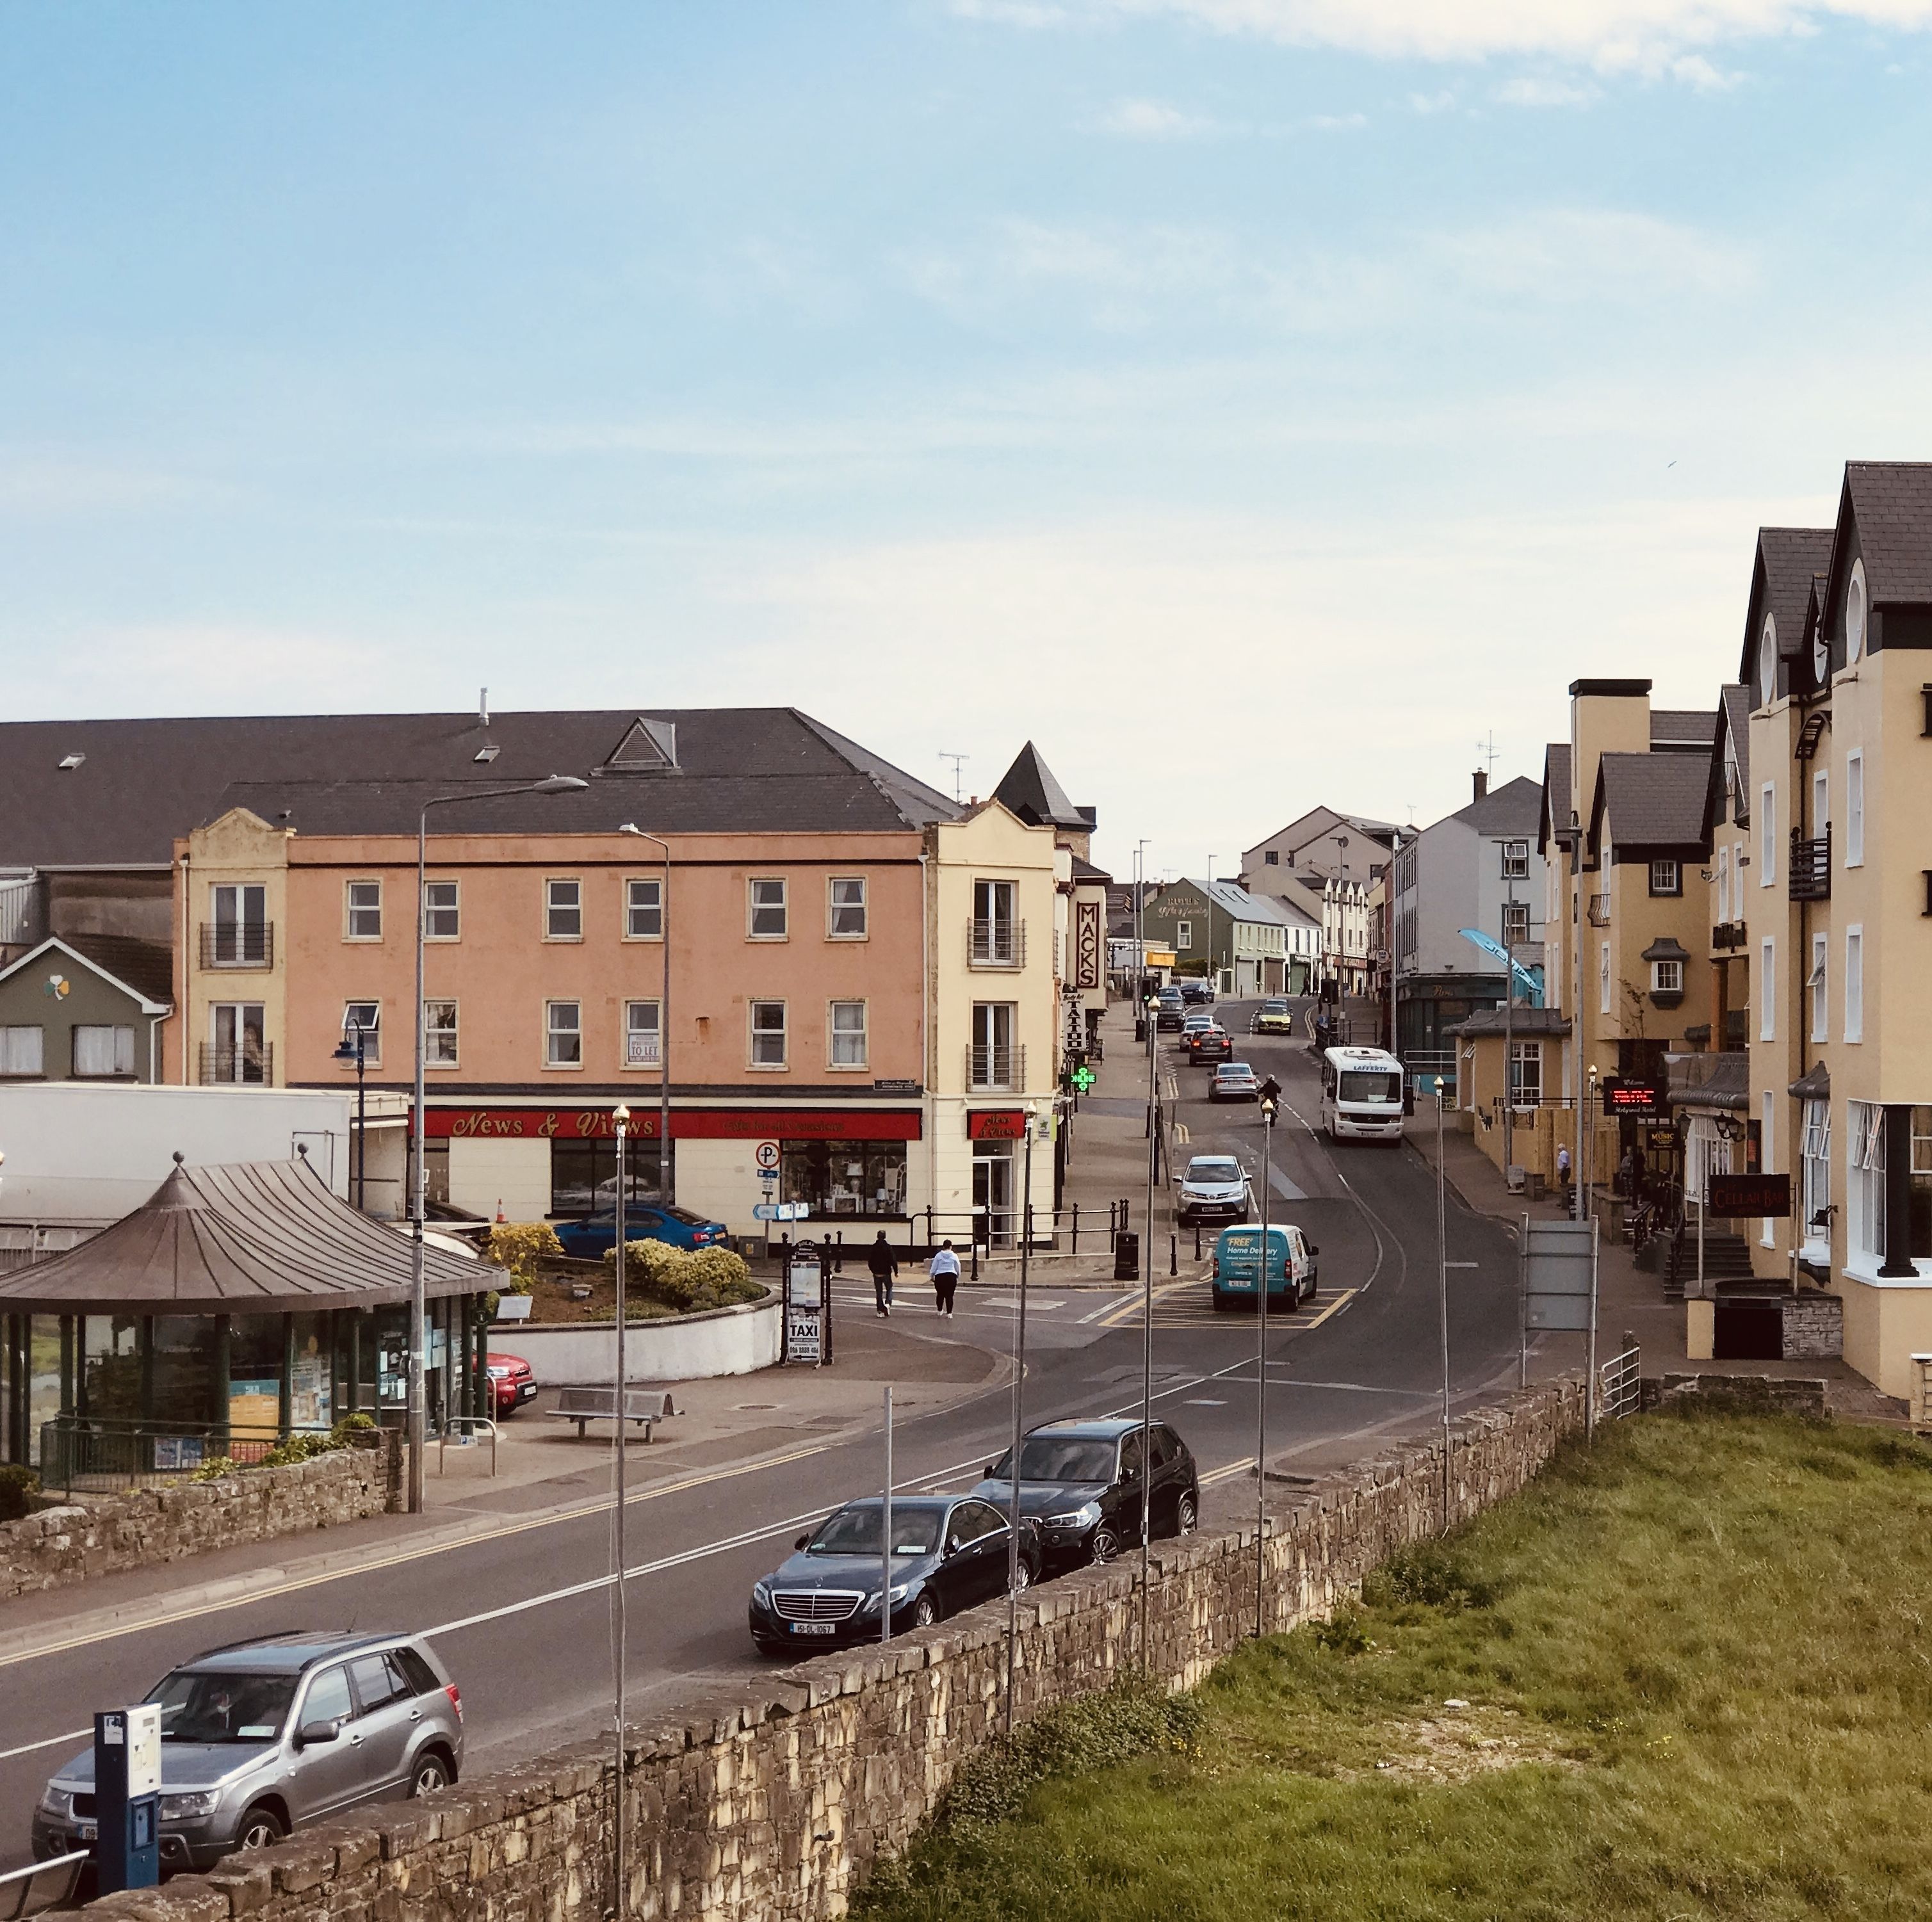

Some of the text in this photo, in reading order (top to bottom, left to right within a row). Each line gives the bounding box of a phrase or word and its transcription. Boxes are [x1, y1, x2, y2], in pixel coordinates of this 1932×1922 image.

[1080, 907, 1095, 985] MACKS
[1067, 1001, 1082, 1047] TATTOO
[631, 1046, 658, 1056] TO LET
[452, 1111, 524, 1136] News
[537, 1113, 560, 1136] &
[790, 1325, 818, 1337] TAXI
